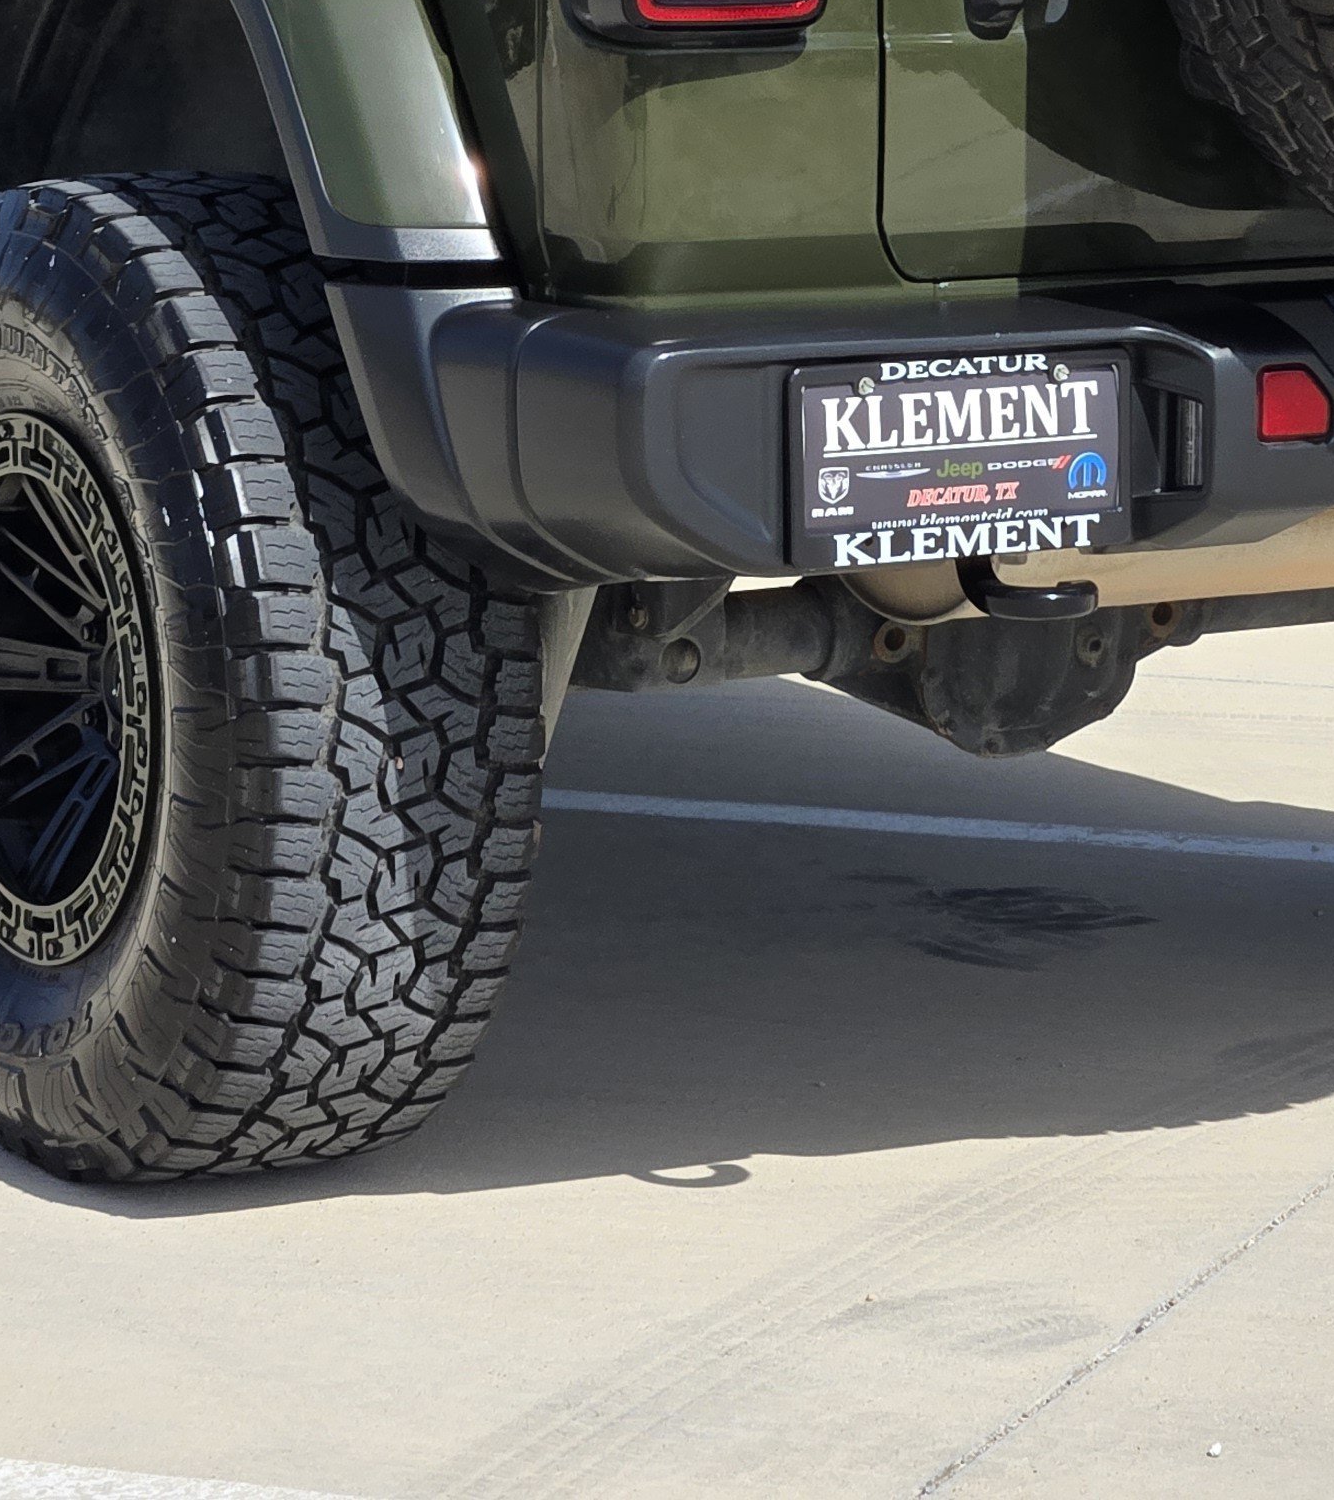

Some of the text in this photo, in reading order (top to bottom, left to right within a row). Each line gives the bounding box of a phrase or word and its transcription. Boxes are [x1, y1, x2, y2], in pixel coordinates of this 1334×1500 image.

[881, 354, 1048, 381] DECATUR
[821, 381, 1099, 452] KLEMENT
[936, 459, 983, 479] Jeep
[987, 457, 1059, 471] DODGE
[906, 481, 1020, 507] DECATUR, TX
[811, 506, 854, 518] RAM
[833, 513, 1100, 568] KLEMENT
